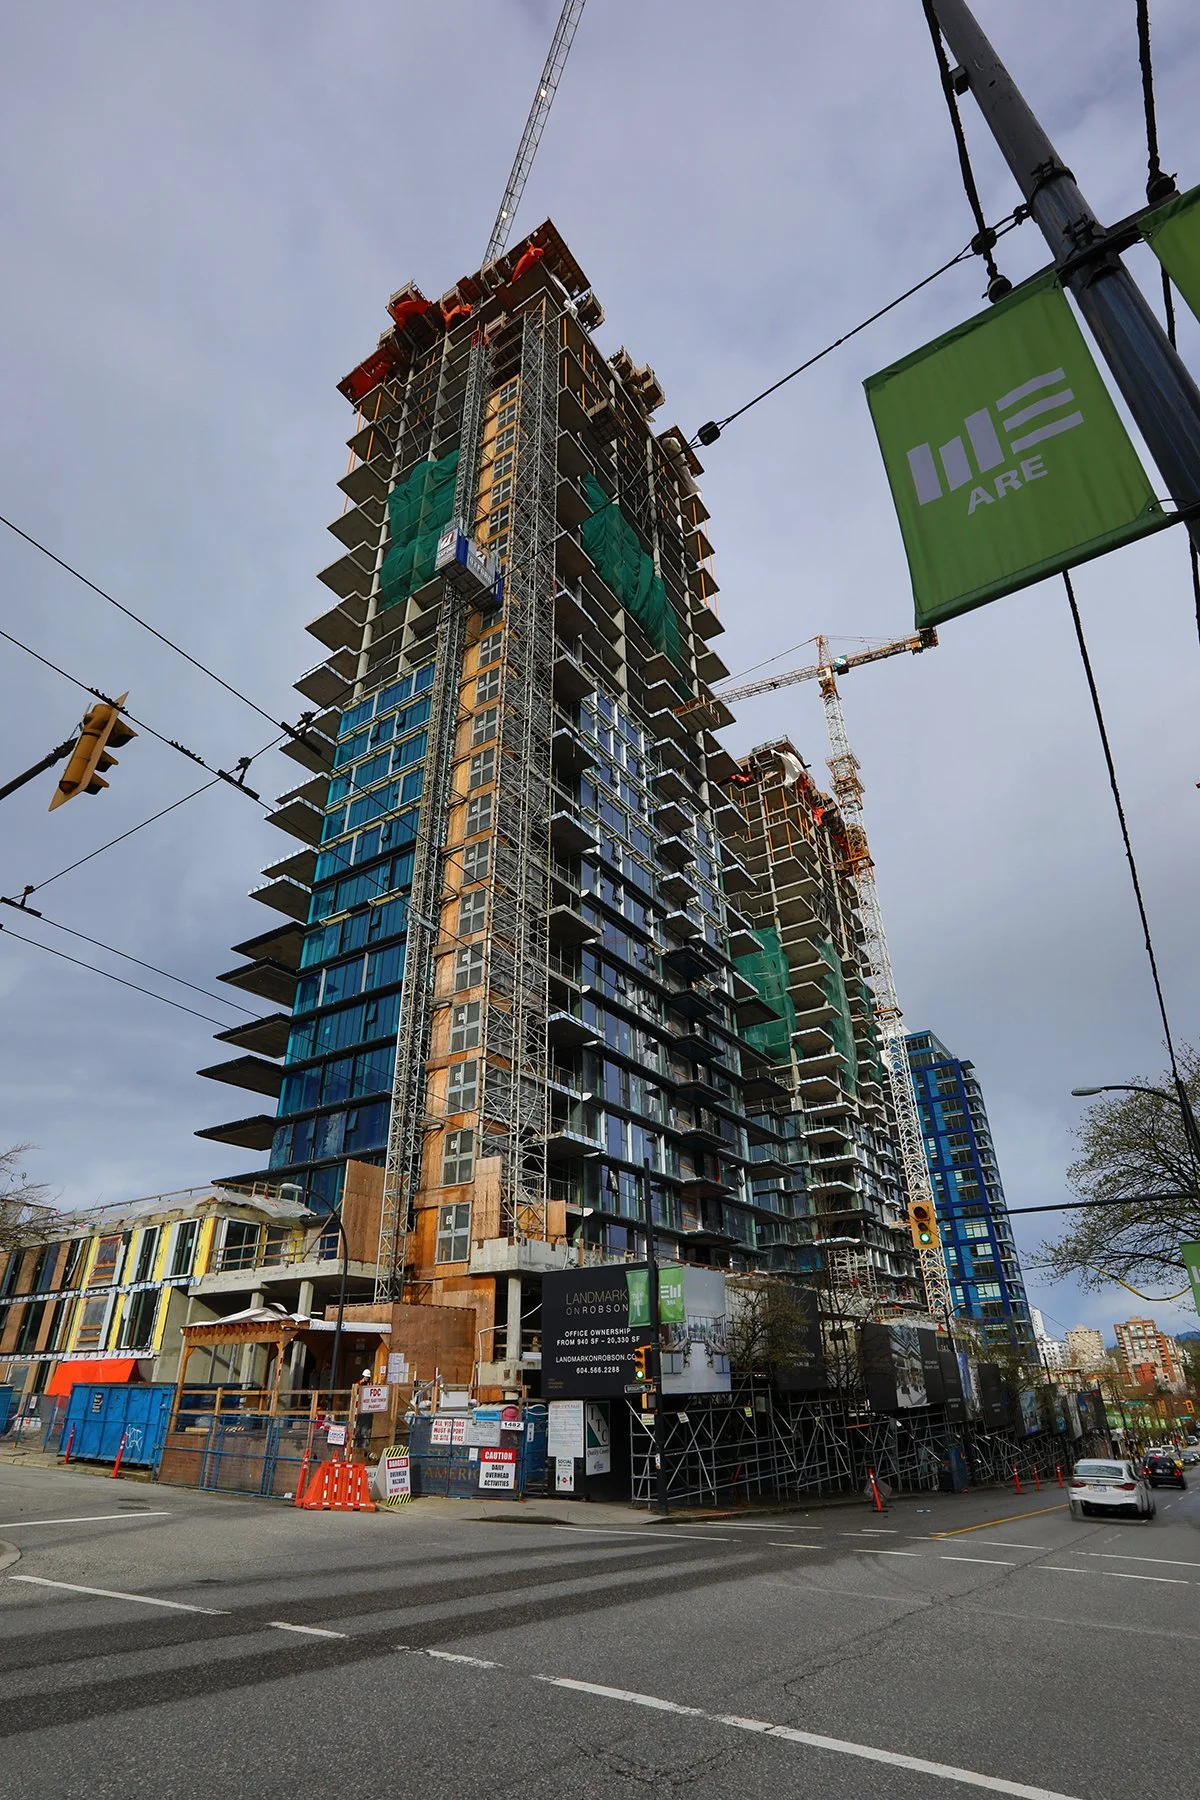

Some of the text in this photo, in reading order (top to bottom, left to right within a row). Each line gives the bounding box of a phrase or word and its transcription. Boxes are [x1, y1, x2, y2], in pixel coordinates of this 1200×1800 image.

[967, 454, 1048, 515] ARE
[565, 1289, 628, 1305] LANDMARK
[564, 1328, 632, 1338] OFFICE OWNERSHIP
[555, 1354, 637, 1363] LANDMARKONROBSON.CO
[369, 1388, 382, 1397] FDC
[588, 1407, 608, 1443] ITC
[484, 1451, 513, 1461] CAUTION
